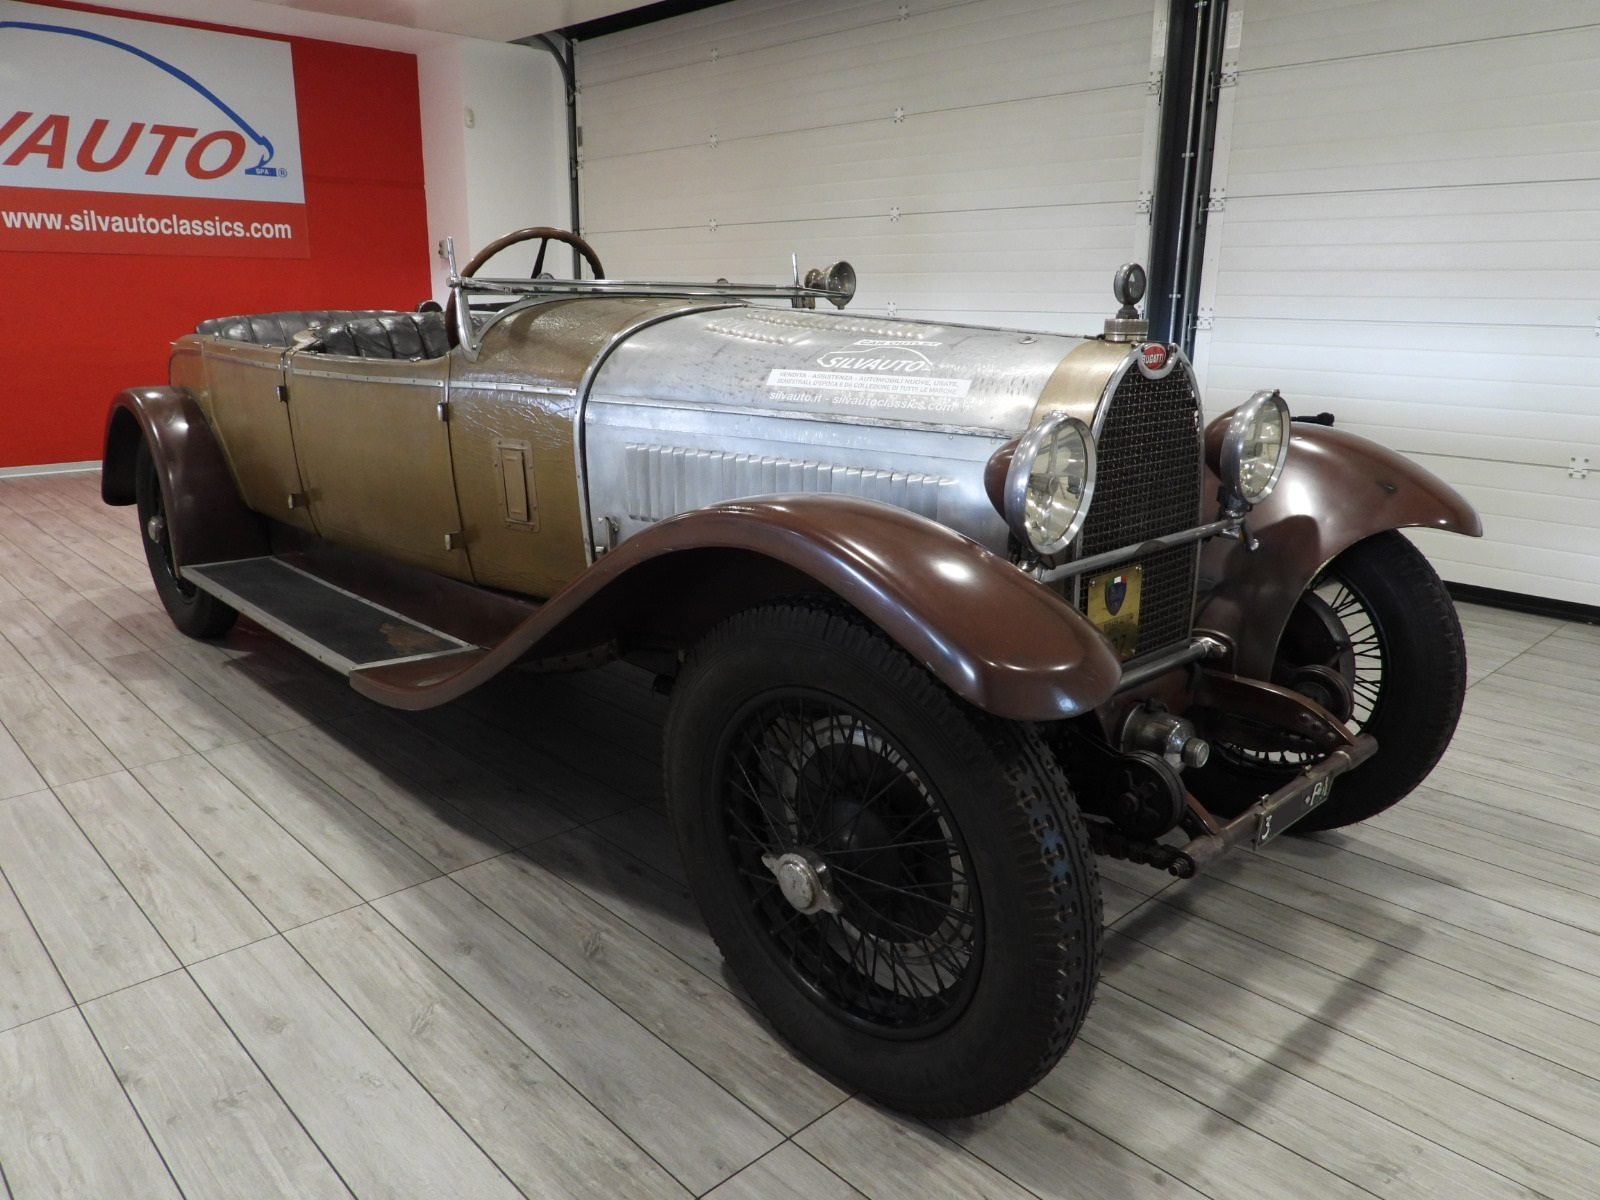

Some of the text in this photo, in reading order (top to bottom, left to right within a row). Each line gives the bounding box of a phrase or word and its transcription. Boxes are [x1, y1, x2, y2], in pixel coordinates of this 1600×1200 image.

[1, 209, 292, 239] www.silvautoclassics.com
[826, 357, 926, 372] SILVAUTO
[1142, 353, 1164, 363] BUGATTI
[769, 391, 822, 403] silvauto.it
[832, 394, 954, 412] silvautoclassics.com
